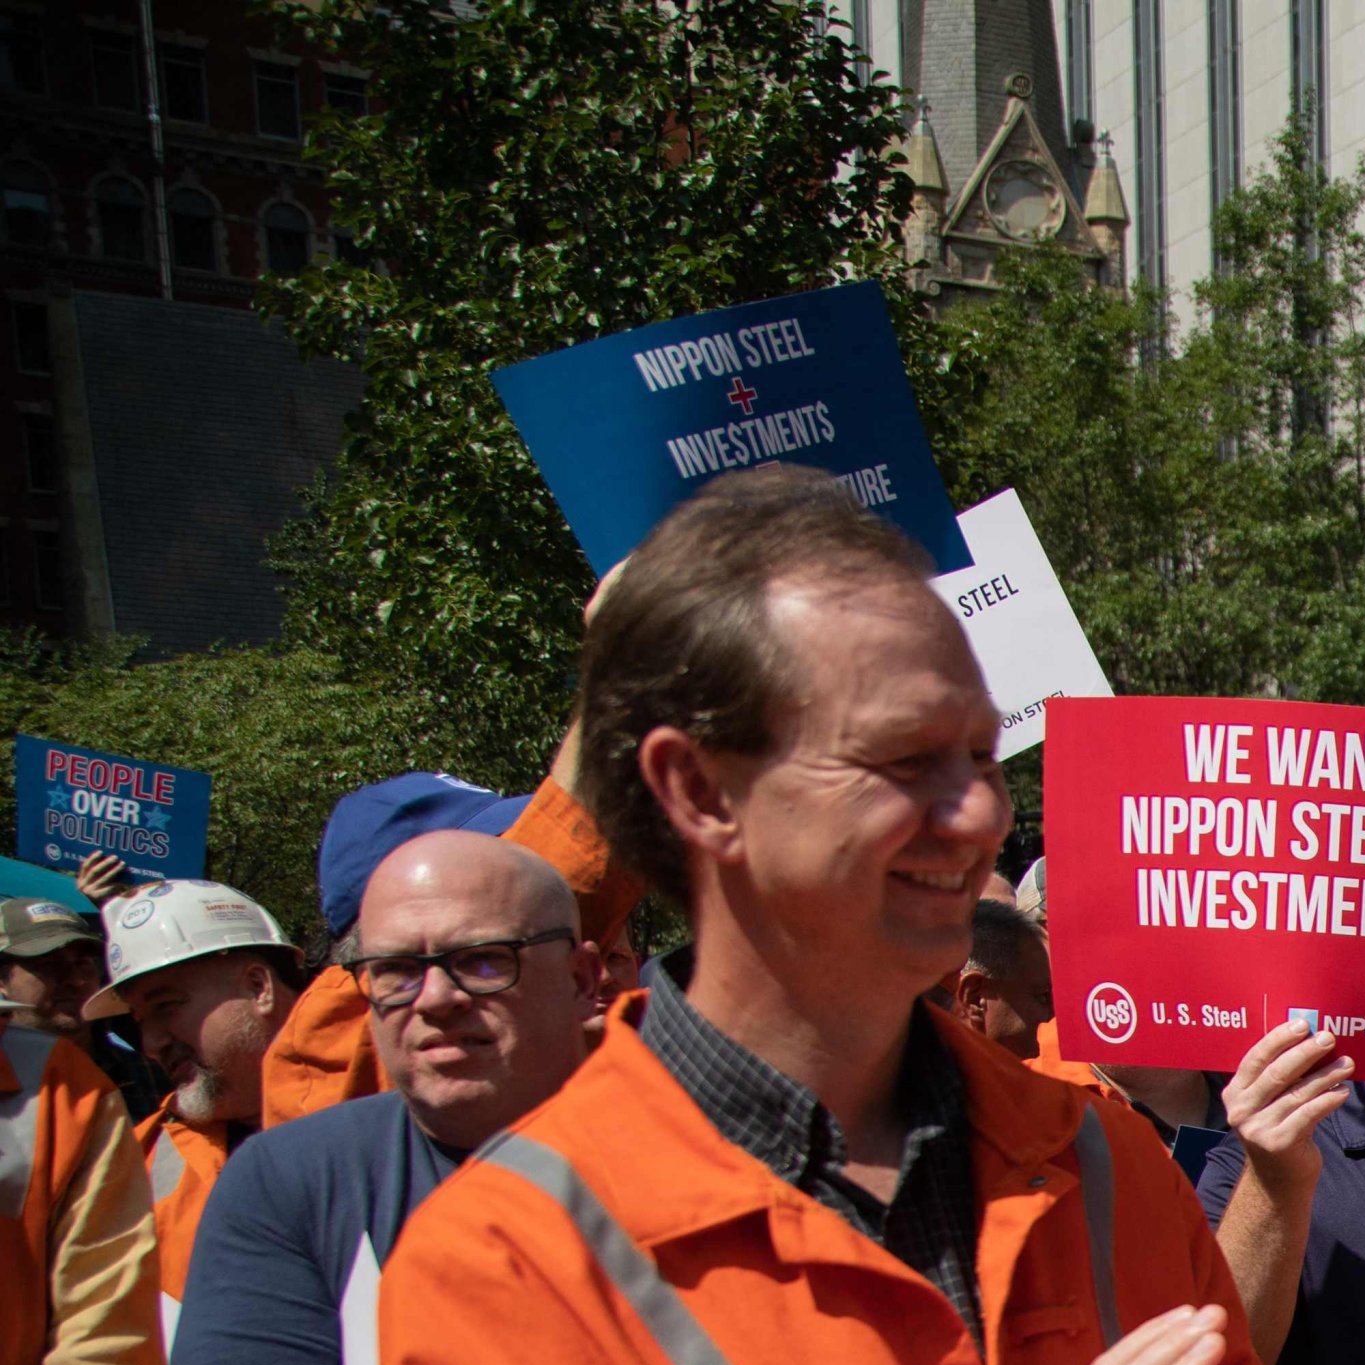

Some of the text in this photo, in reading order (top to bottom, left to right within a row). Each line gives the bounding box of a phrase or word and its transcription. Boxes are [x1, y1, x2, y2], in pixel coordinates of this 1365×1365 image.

[633, 318, 815, 392] NIPPON STEEL
[667, 401, 836, 478] INVE$TMENT$
[957, 574, 1020, 618] STEEL
[45, 749, 176, 805] PEOPLE
[1183, 724, 1253, 784] WE
[45, 808, 170, 859] POLITICS
[72, 789, 141, 825] OVER
[1121, 796, 1277, 858] NIPPON
[1152, 1002, 1171, 1025] U.
[1178, 1004, 1197, 1027] S.
[1201, 1004, 1247, 1029] Steel
